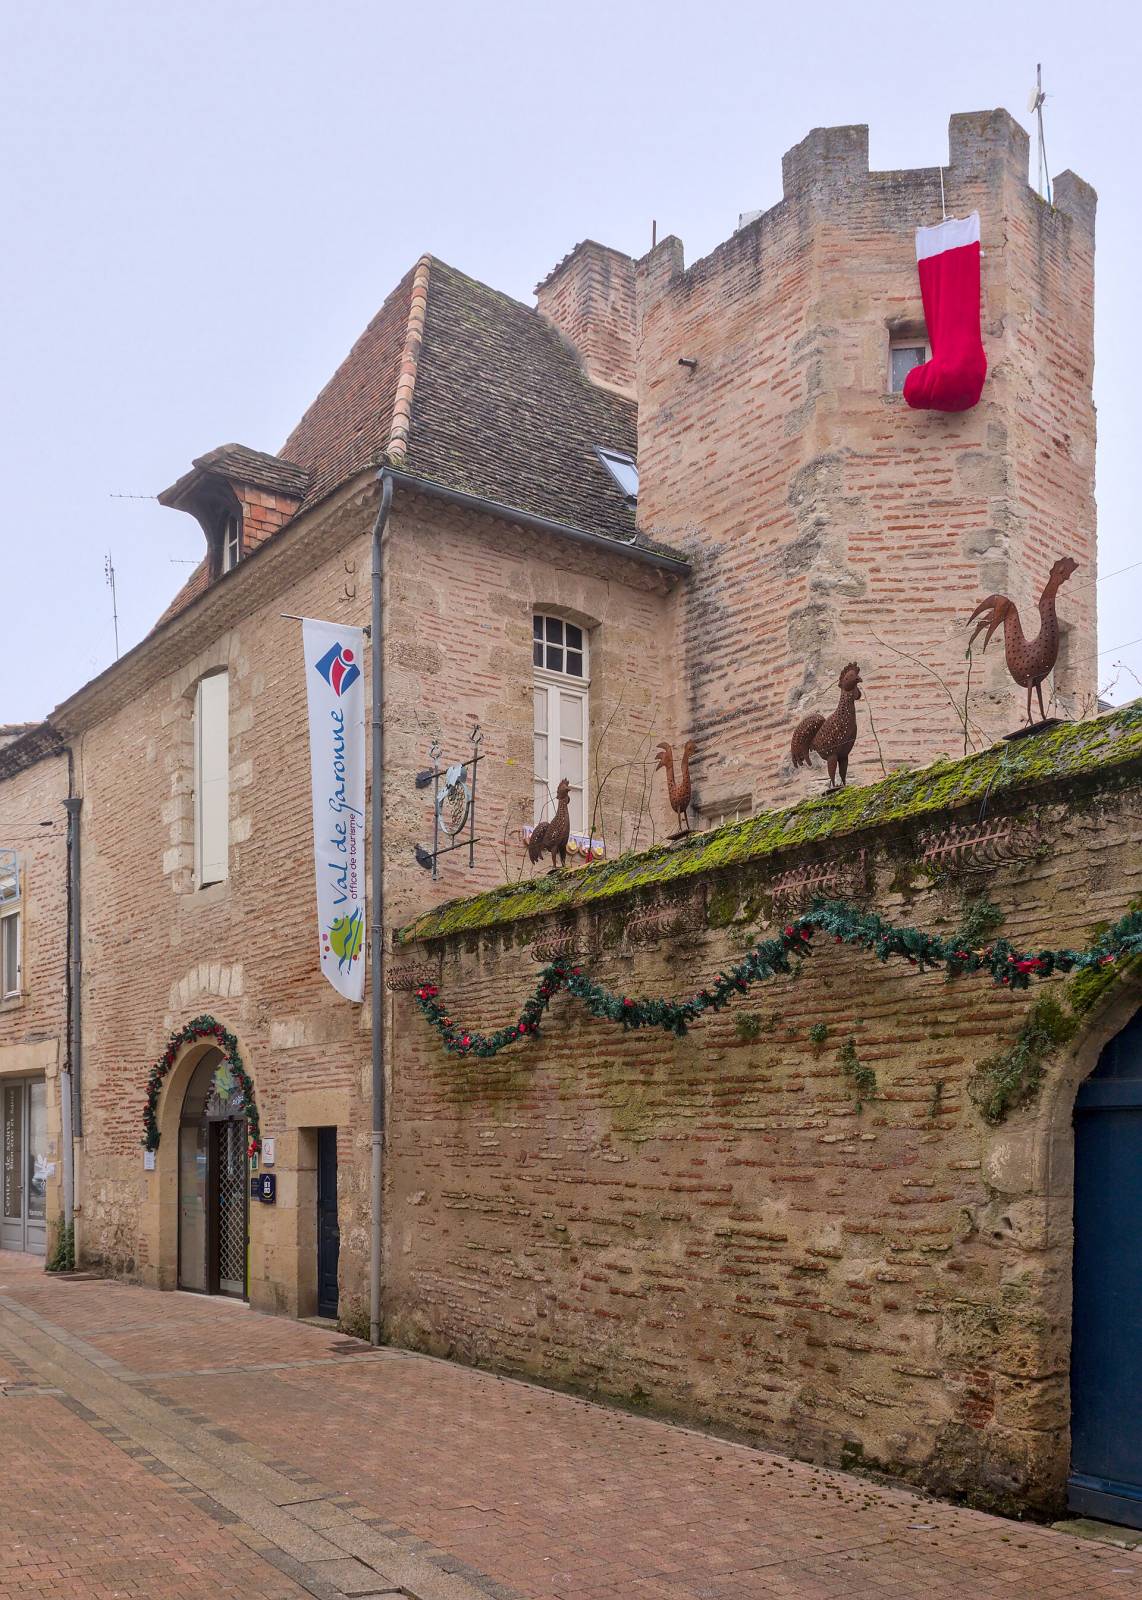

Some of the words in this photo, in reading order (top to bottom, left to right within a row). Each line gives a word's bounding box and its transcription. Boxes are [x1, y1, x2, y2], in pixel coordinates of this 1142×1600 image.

[328, 708, 363, 828] Garonne
[329, 821, 347, 853] de
[348, 813, 358, 855] tourisme
[348, 858, 357, 870] de
[327, 862, 348, 905] Val
[348, 872, 358, 900] office
[4, 1155, 11, 1171] de
